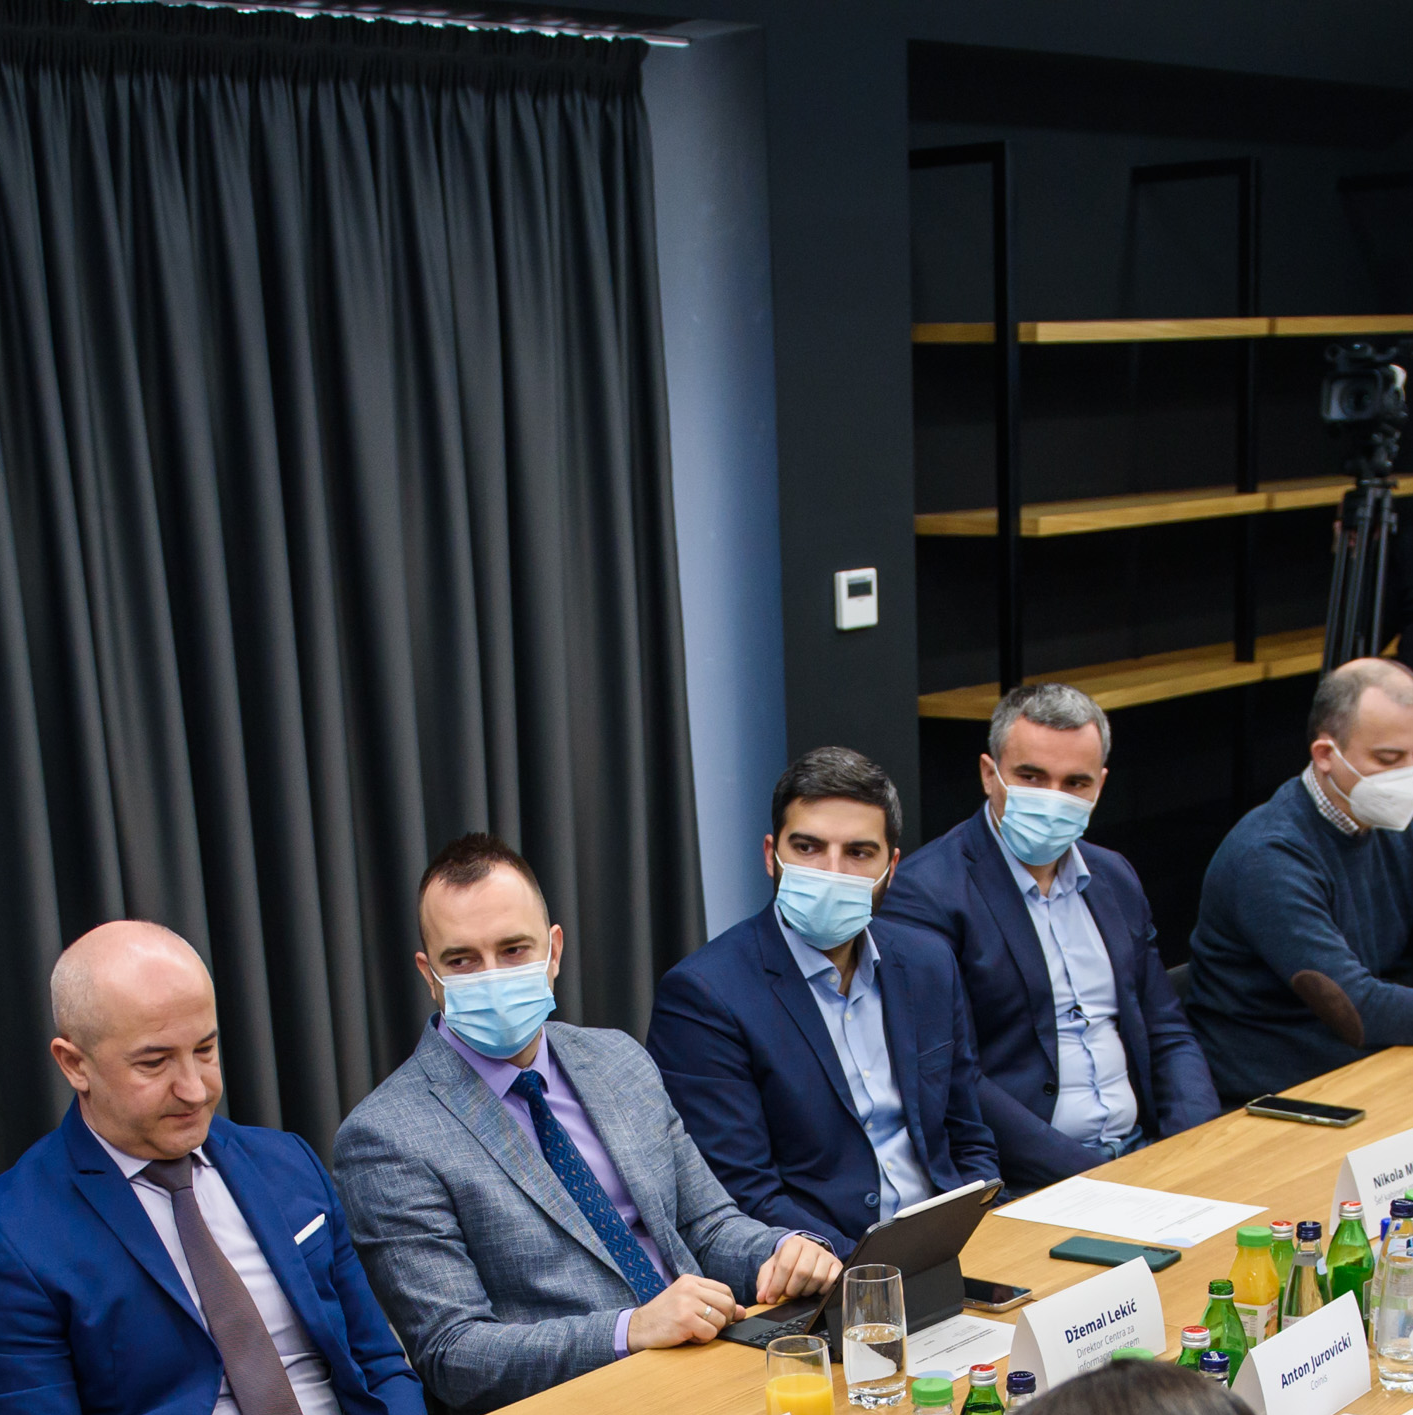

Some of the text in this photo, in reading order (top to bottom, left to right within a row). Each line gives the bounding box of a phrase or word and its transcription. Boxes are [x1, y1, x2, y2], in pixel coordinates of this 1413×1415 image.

[1372, 1168, 1404, 1189] Nikola
[1064, 1297, 1138, 1344] Džemal Lekić
[1076, 1324, 1136, 1359] Direktor Centra za
[1280, 1331, 1352, 1390] Anton Jurovicki
